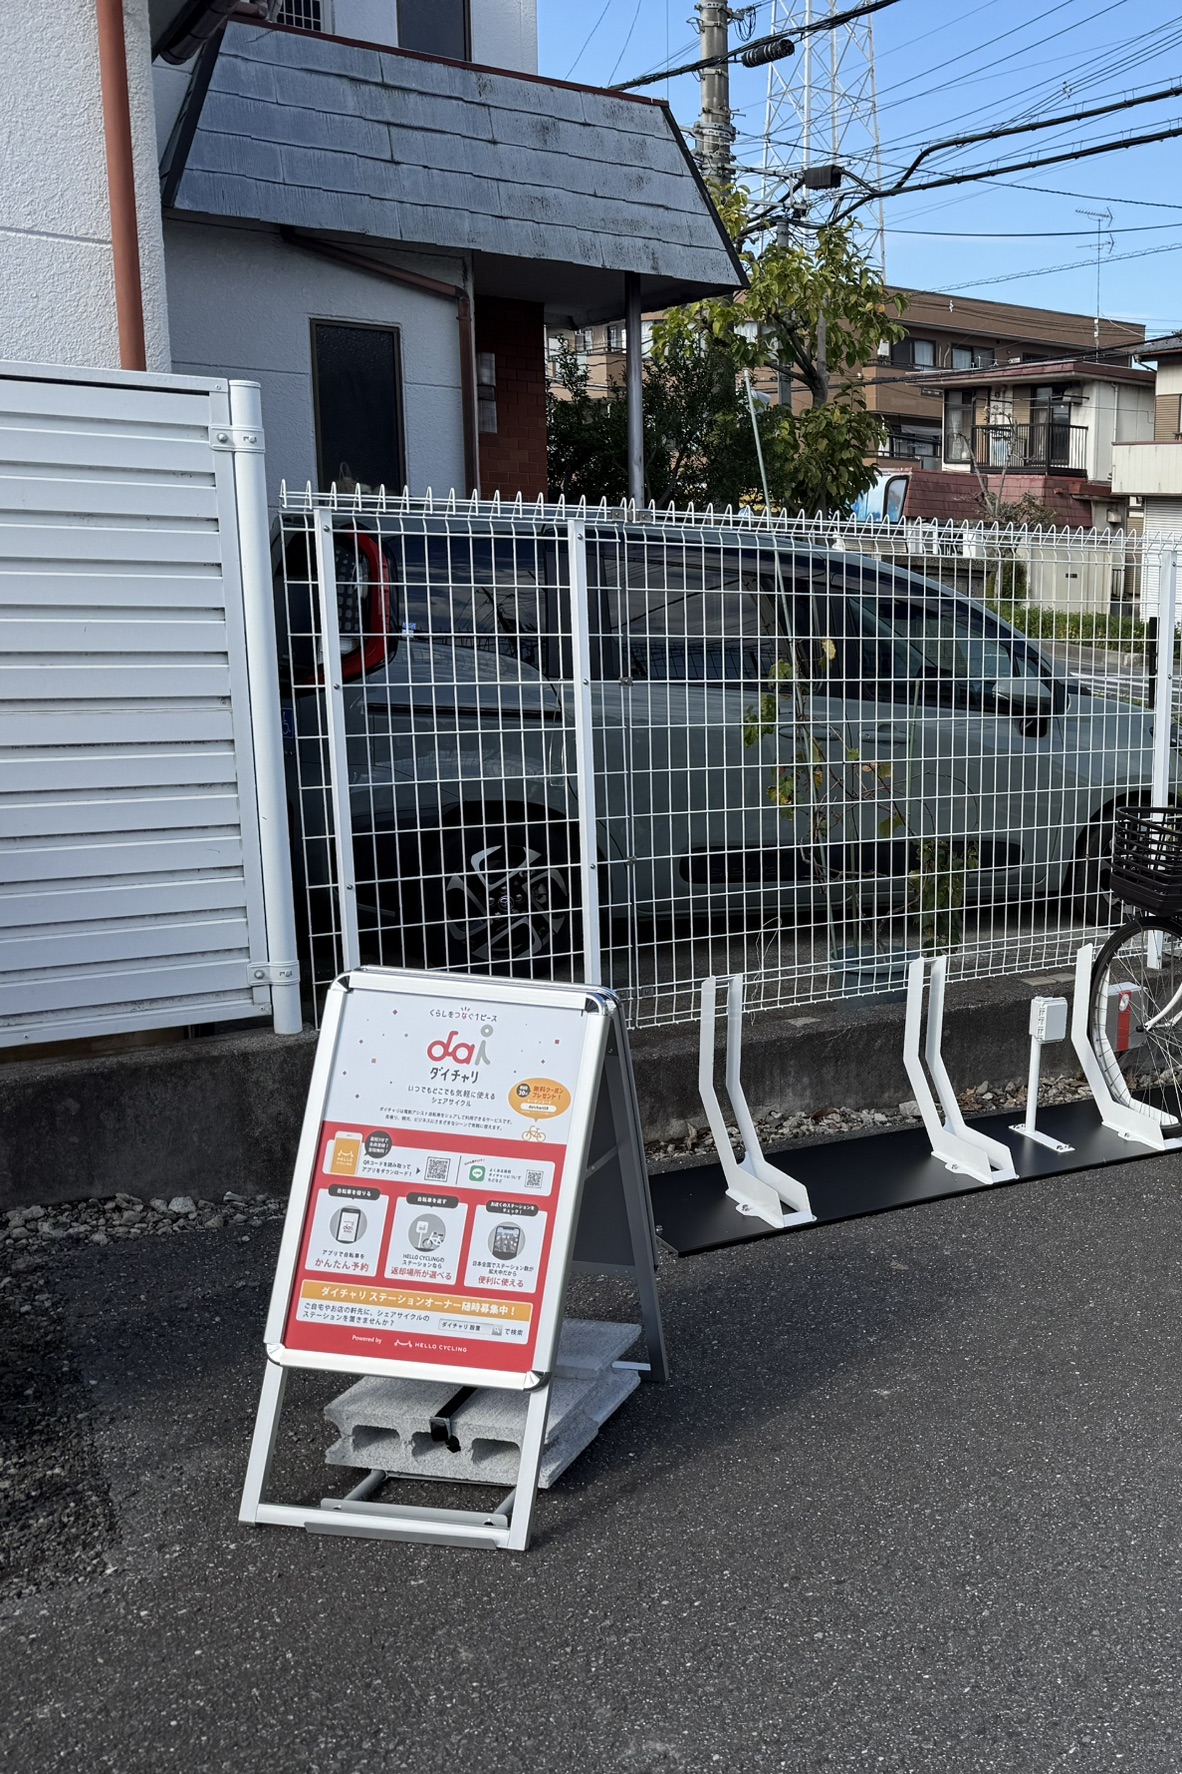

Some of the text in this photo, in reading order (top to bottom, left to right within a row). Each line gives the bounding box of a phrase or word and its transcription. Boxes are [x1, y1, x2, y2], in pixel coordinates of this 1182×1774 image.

[429, 1009, 498, 1022] くらしをつなぐ1ピース
[427, 1024, 494, 1066] dai
[430, 1067, 479, 1084] ダイチャリ
[408, 1085, 496, 1100] いつでもどこでも気軽に使える
[431, 1096, 471, 1107] シェアサイクル
[363, 1159, 411, 1169] QRコードを読み取って
[362, 1166, 412, 1176] アプリをダウンロード！
[337, 1188, 371, 1197] 自転車を借りる
[417, 1196, 447, 1204] 自転車を返す
[490, 1202, 535, 1211] お近くのステーションを
[322, 1250, 365, 1259] アプリで自転車を
[419, 1255, 445, 1263] CYCLINGの
[315, 1258, 369, 1272] かんたん予約
[402, 1260, 443, 1269] ステーションなら
[472, 1260, 534, 1272] 日本全国でステーション数が
[391, 1267, 452, 1280] 返却場所が選べる
[488, 1269, 517, 1277] 拡大中だから
[478, 1276, 524, 1288] 便利に使える
[321, 1287, 515, 1316] ダイチャリ ステーションオーナー随時募集中！
[304, 1302, 430, 1322] ご自宅やお店の軒先に、シェアサイクルの
[302, 1311, 395, 1326] ステーションを置きませんか？
[442, 1322, 468, 1330] ダイチャリ
[352, 1335, 383, 1344] Powered by
[414, 1342, 468, 1353] HELLO CYCLING
